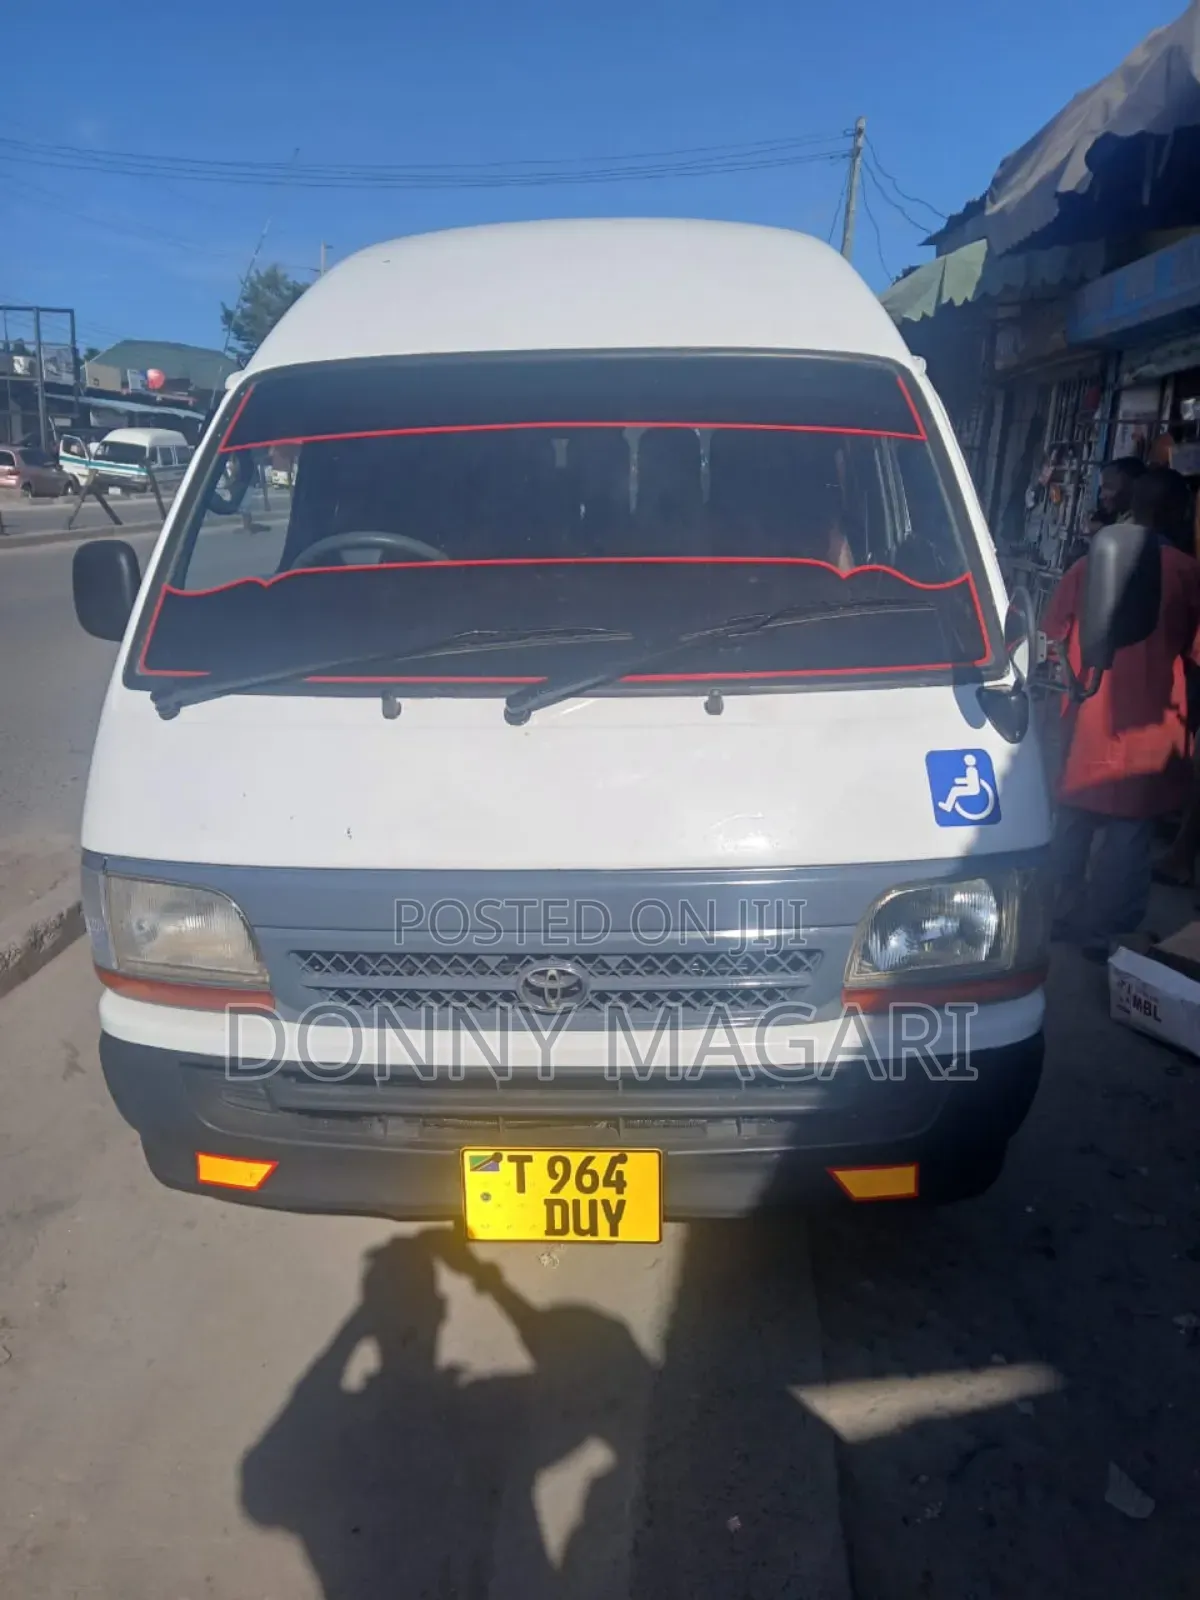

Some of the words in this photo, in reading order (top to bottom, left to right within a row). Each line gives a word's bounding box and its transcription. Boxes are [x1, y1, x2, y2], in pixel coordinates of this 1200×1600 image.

[507, 1154, 533, 1194] T
[547, 1154, 628, 1195] 964
[543, 1198, 626, 1237] DUY
